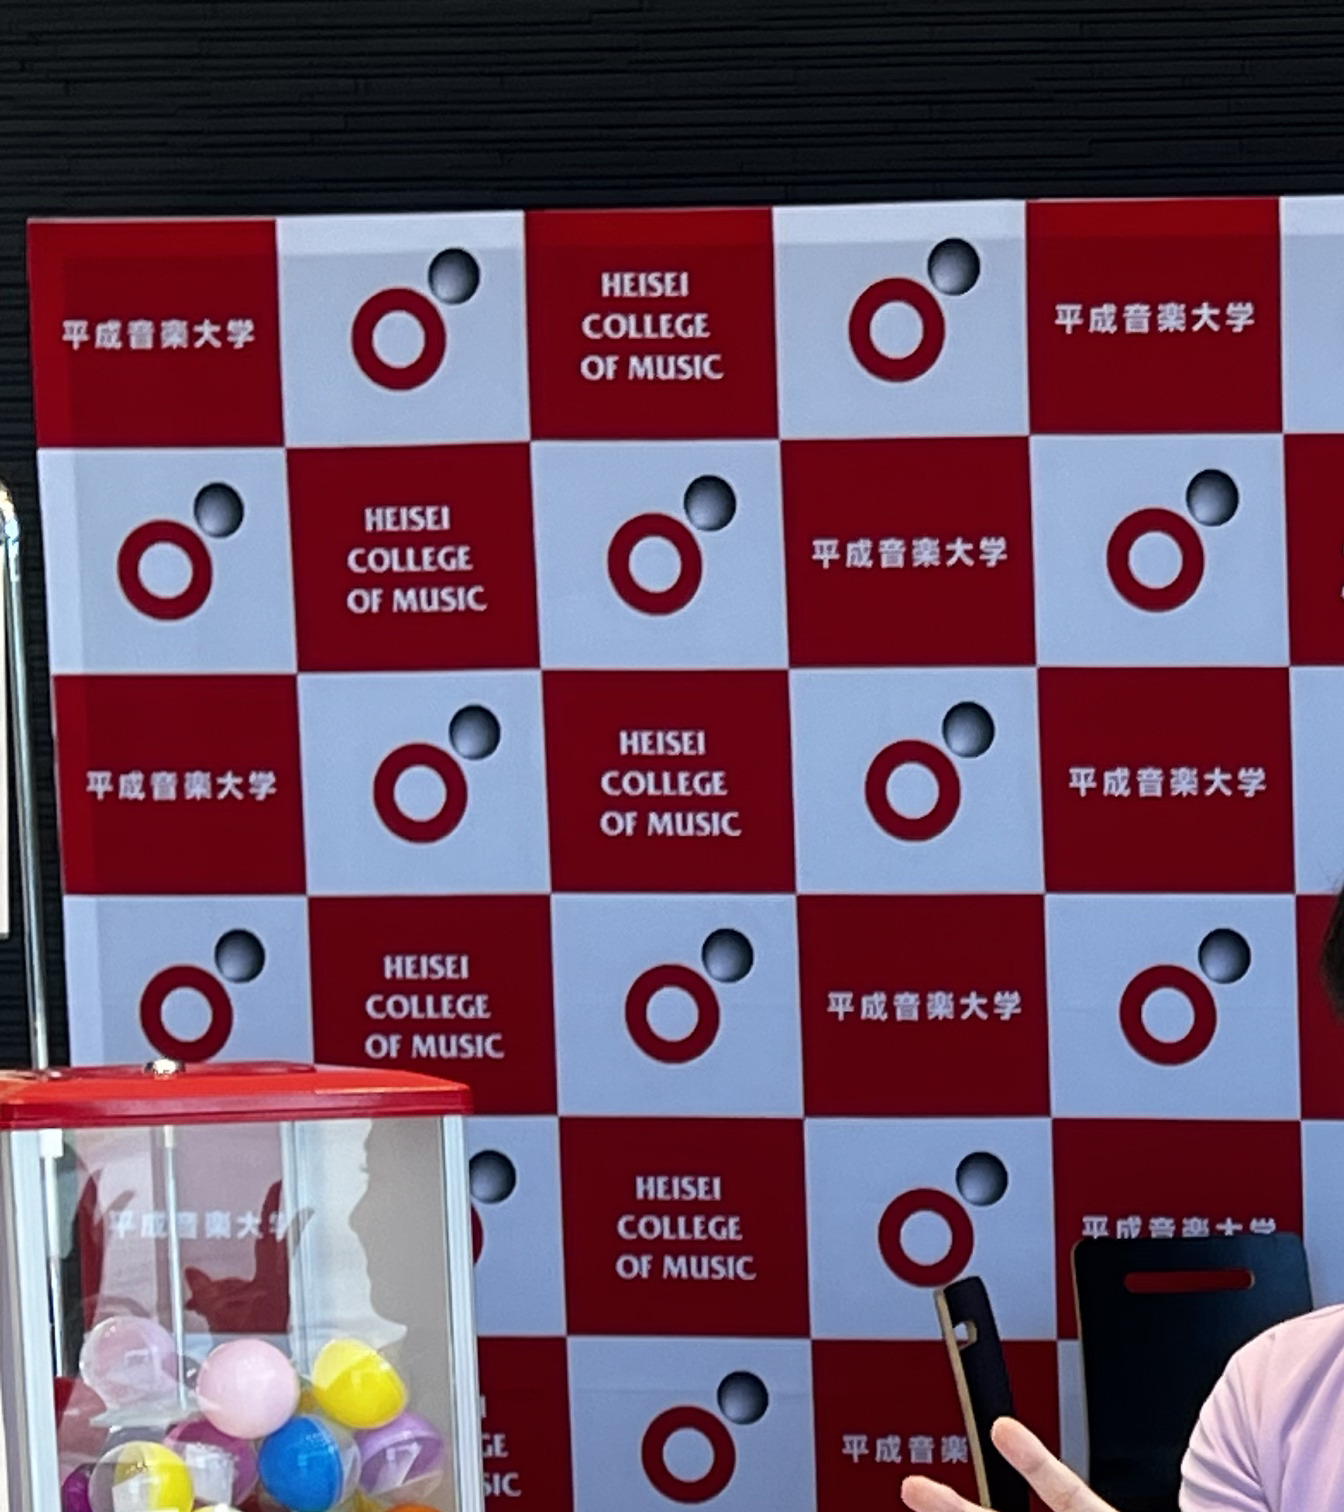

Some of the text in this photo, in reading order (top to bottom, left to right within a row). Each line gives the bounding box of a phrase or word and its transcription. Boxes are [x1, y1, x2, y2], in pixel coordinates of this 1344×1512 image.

[601, 271, 689, 298] HEISEI
[581, 313, 711, 340] COLLEGE
[1054, 301, 1255, 335] 平成音楽大学
[62, 318, 255, 351] 平成音楽大学
[580, 354, 724, 381] OF MUSIC
[364, 505, 451, 532] HEISEI
[347, 545, 473, 574] COLLEGE
[811, 536, 1008, 569] 平成音楽大学
[346, 585, 487, 614] OF MUSIC
[619, 730, 706, 756] HEISEI
[86, 770, 277, 801] 平成音楽大学
[600, 770, 728, 796] COLLEGE
[1068, 766, 1267, 798] 平成音楽大学
[599, 811, 742, 837] OF MUSIC
[383, 954, 469, 980] HEISEI
[365, 994, 491, 1020] COLLEGE
[827, 990, 1022, 1022] 平成音楽大学
[364, 1033, 505, 1059] OF MUSIC
[635, 1175, 721, 1201] HEISEI
[617, 1214, 743, 1241] COLLEGE
[615, 1254, 757, 1281] OF MUSIC
[841, 1434, 968, 1465] 平成音楽
